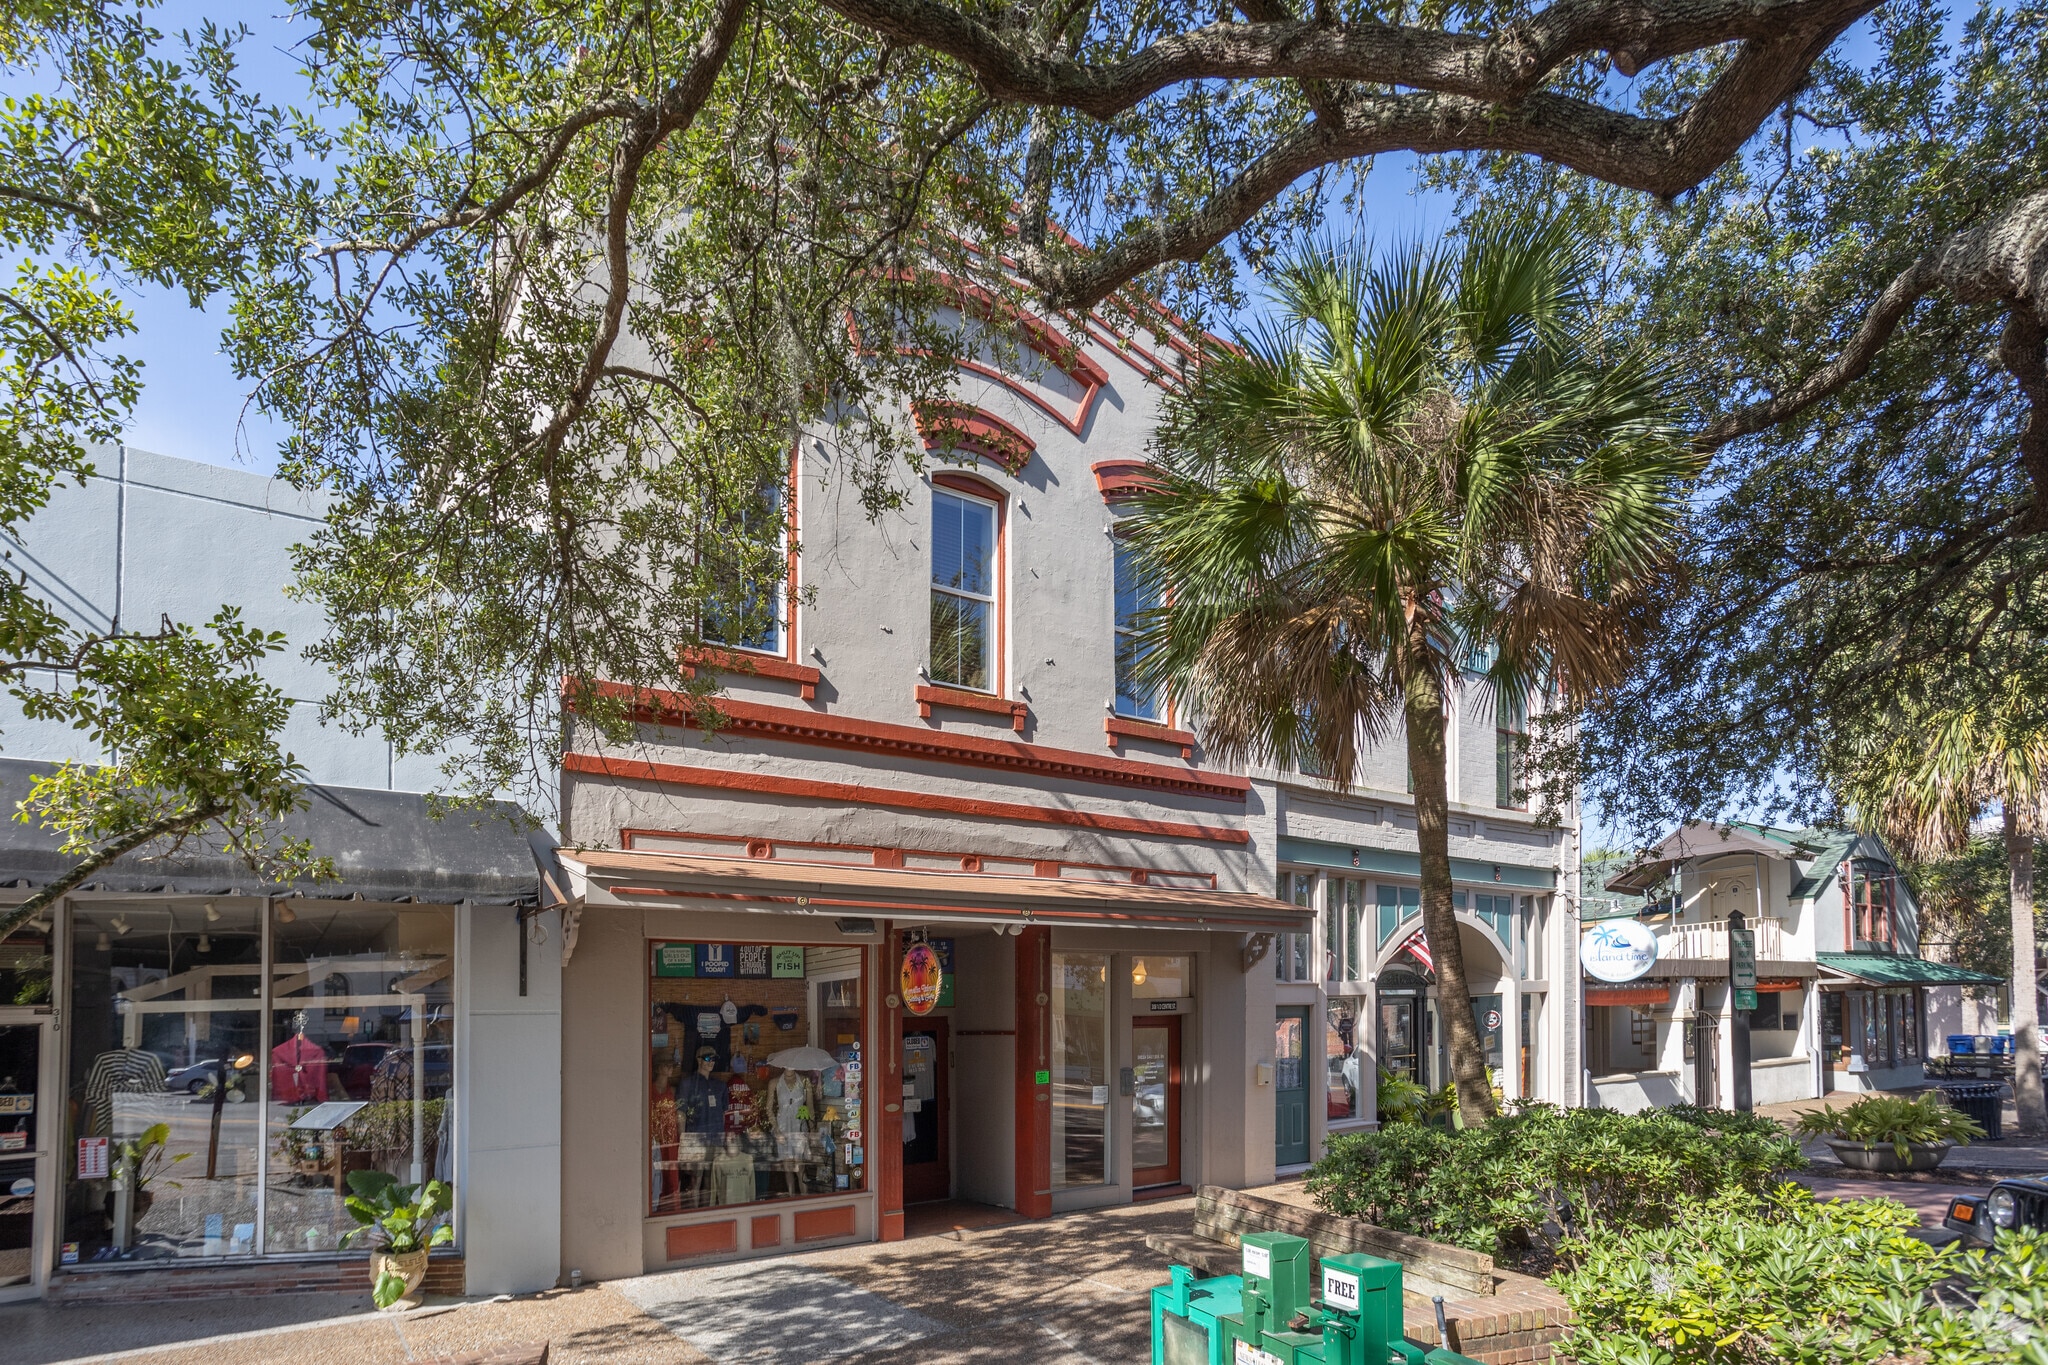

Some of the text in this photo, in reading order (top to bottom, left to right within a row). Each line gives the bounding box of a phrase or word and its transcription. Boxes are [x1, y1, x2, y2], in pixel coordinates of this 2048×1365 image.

[1734, 940, 1752, 948] THREE
[739, 952, 766, 962] PEOPLE
[1590, 952, 1649, 962] island time
[739, 961, 766, 969] STRUGGLE
[776, 962, 800, 970] FISH
[1736, 961, 1753, 970] PARKING
[753, 967, 766, 975] MATH
[906, 1037, 920, 1045] CLOSED
[1328, 1277, 1355, 1300] FREE
